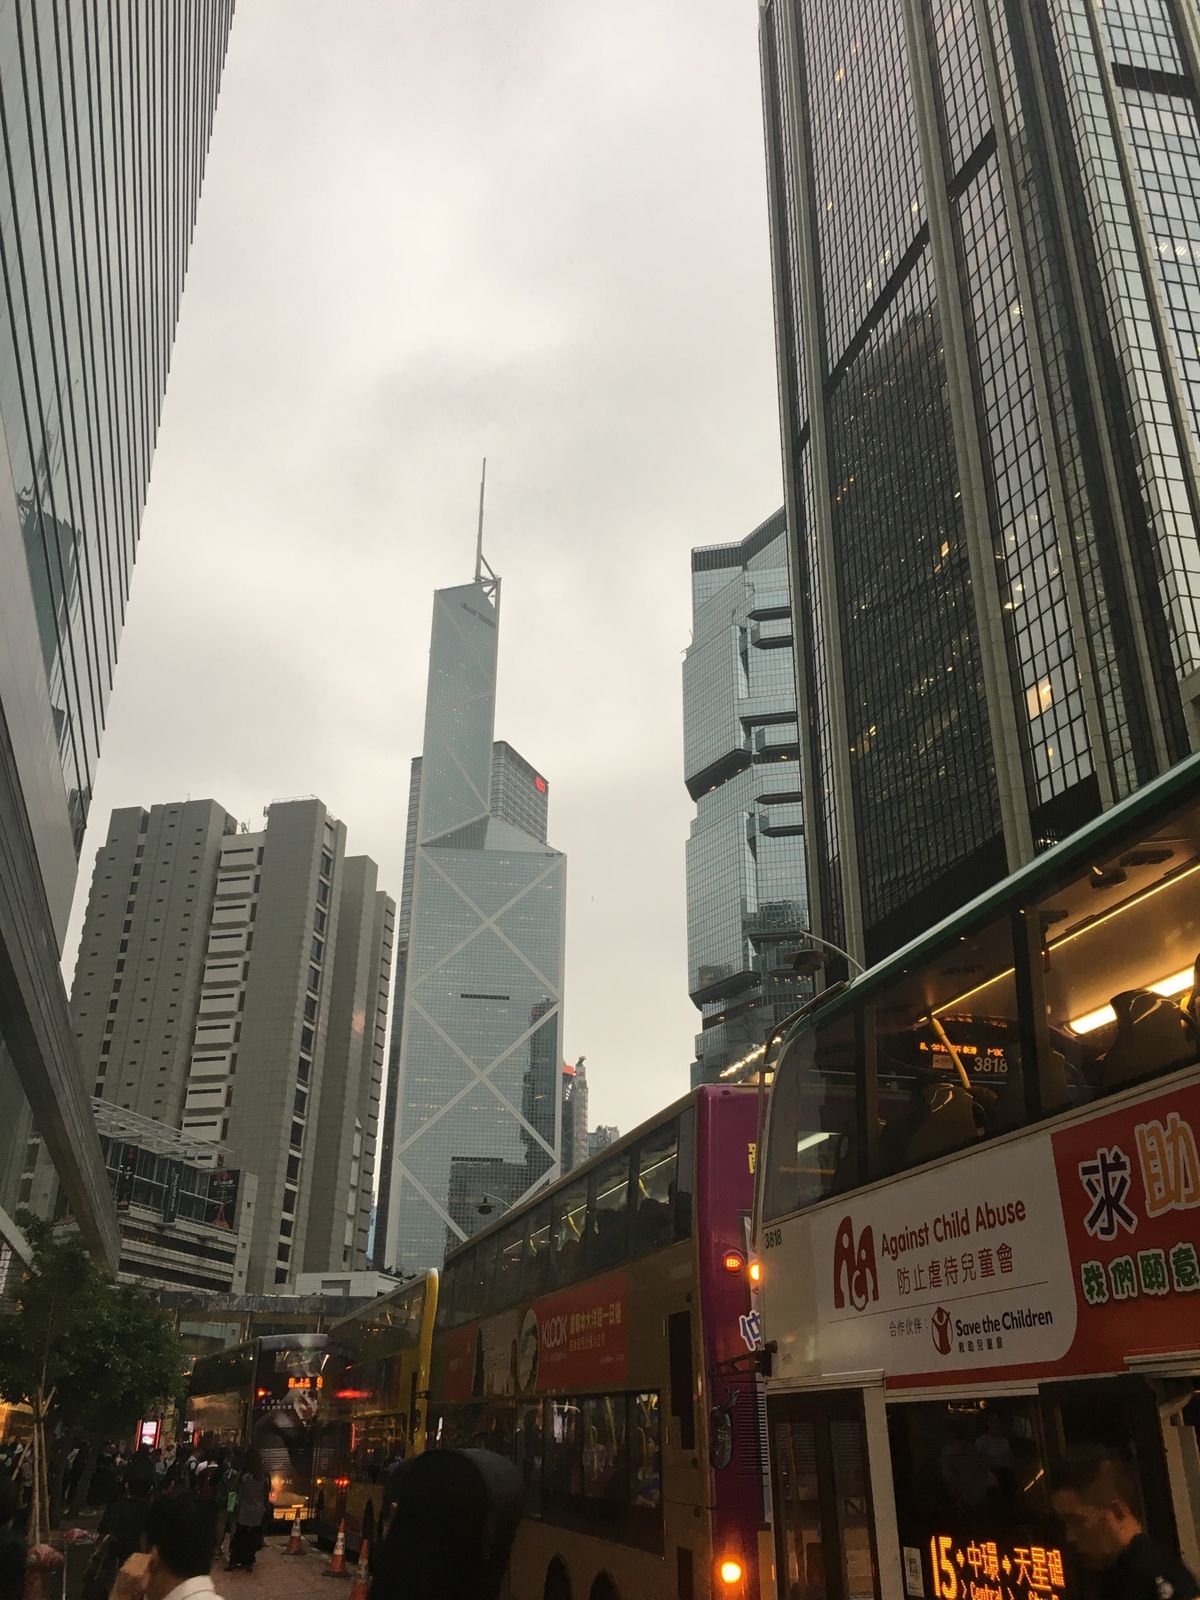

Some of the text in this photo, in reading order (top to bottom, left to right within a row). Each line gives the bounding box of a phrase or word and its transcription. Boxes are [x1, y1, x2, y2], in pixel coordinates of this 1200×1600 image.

[974, 1057, 1008, 1073] 3818
[764, 1228, 782, 1249] 3818
[881, 1200, 1026, 1260] Against Child Abuse
[897, 1243, 1013, 1296] 防止虐待兒童會
[542, 1314, 567, 1349] KLOOK
[955, 1308, 1053, 1337] Save the Children
[930, 1536, 957, 1599] 15
[967, 1540, 1000, 1581] 中環
